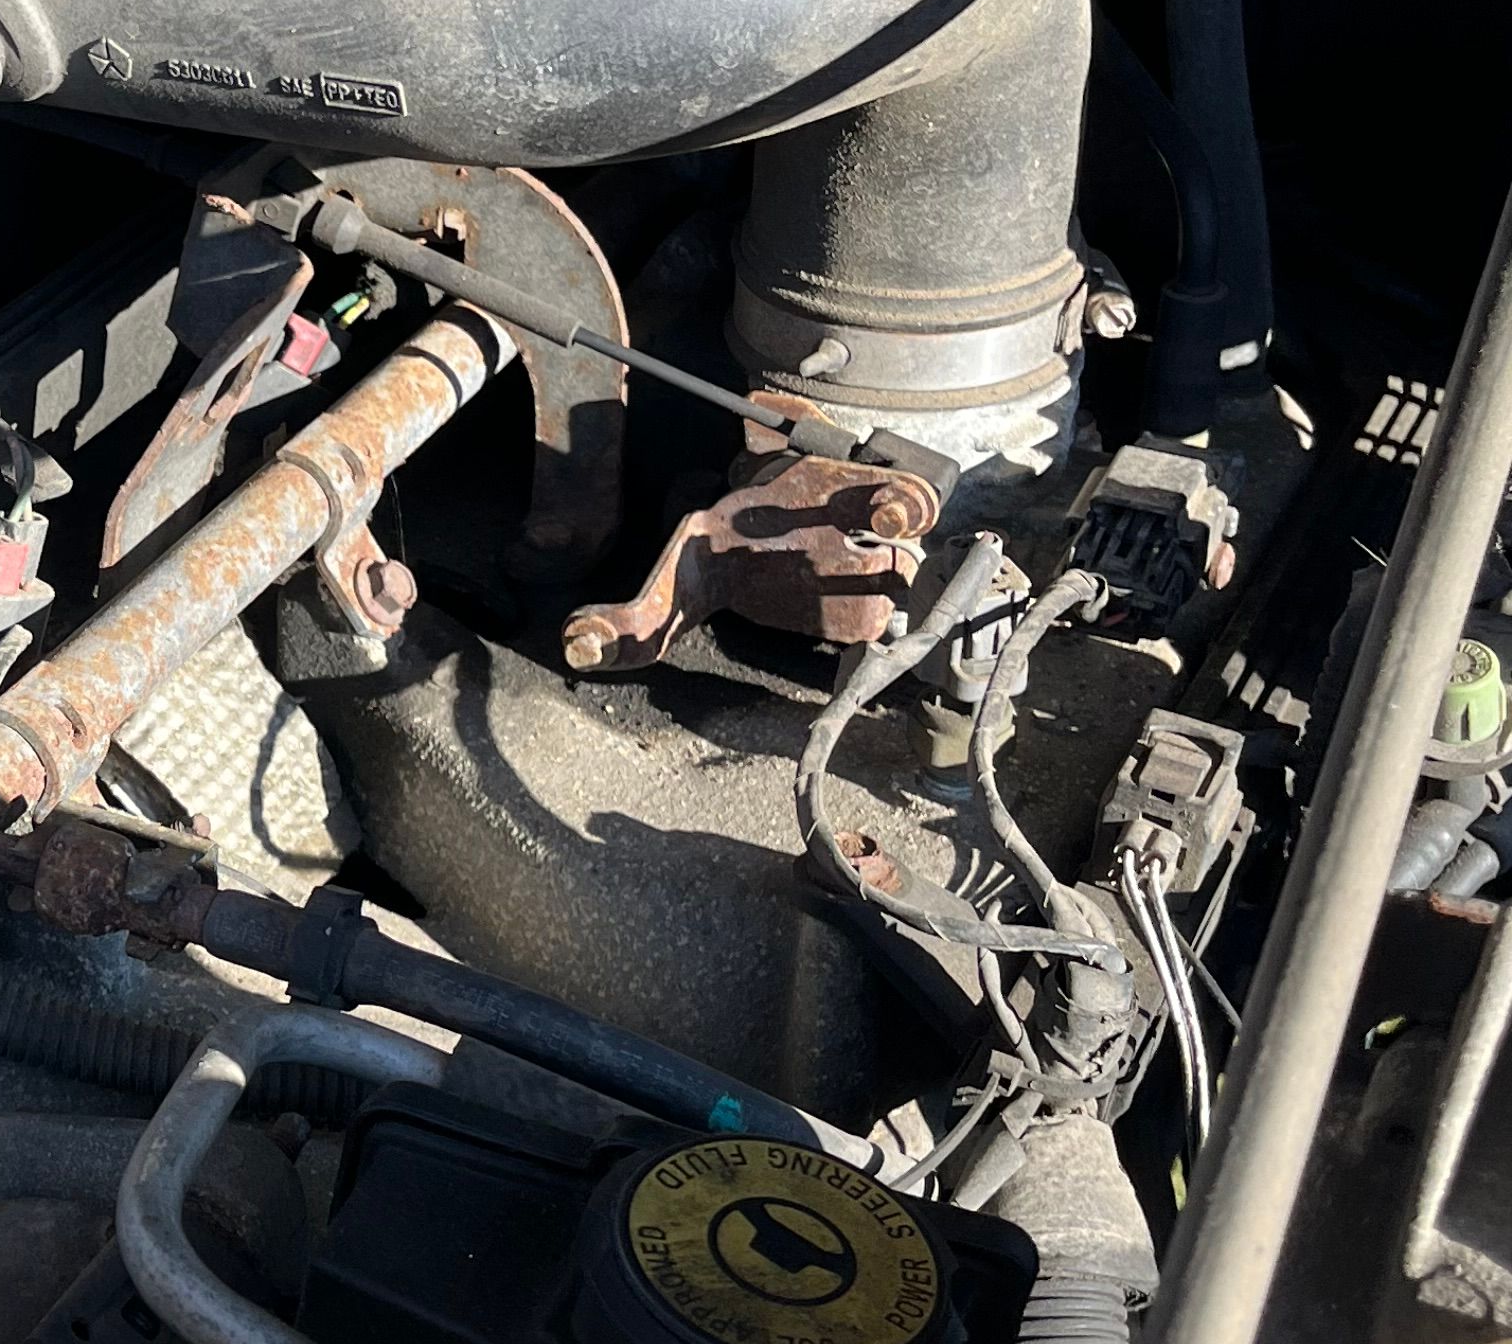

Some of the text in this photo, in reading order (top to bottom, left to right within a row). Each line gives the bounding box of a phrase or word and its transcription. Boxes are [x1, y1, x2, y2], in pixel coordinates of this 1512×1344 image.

[654, 1144, 932, 1334] POWER STEERING FLUID
